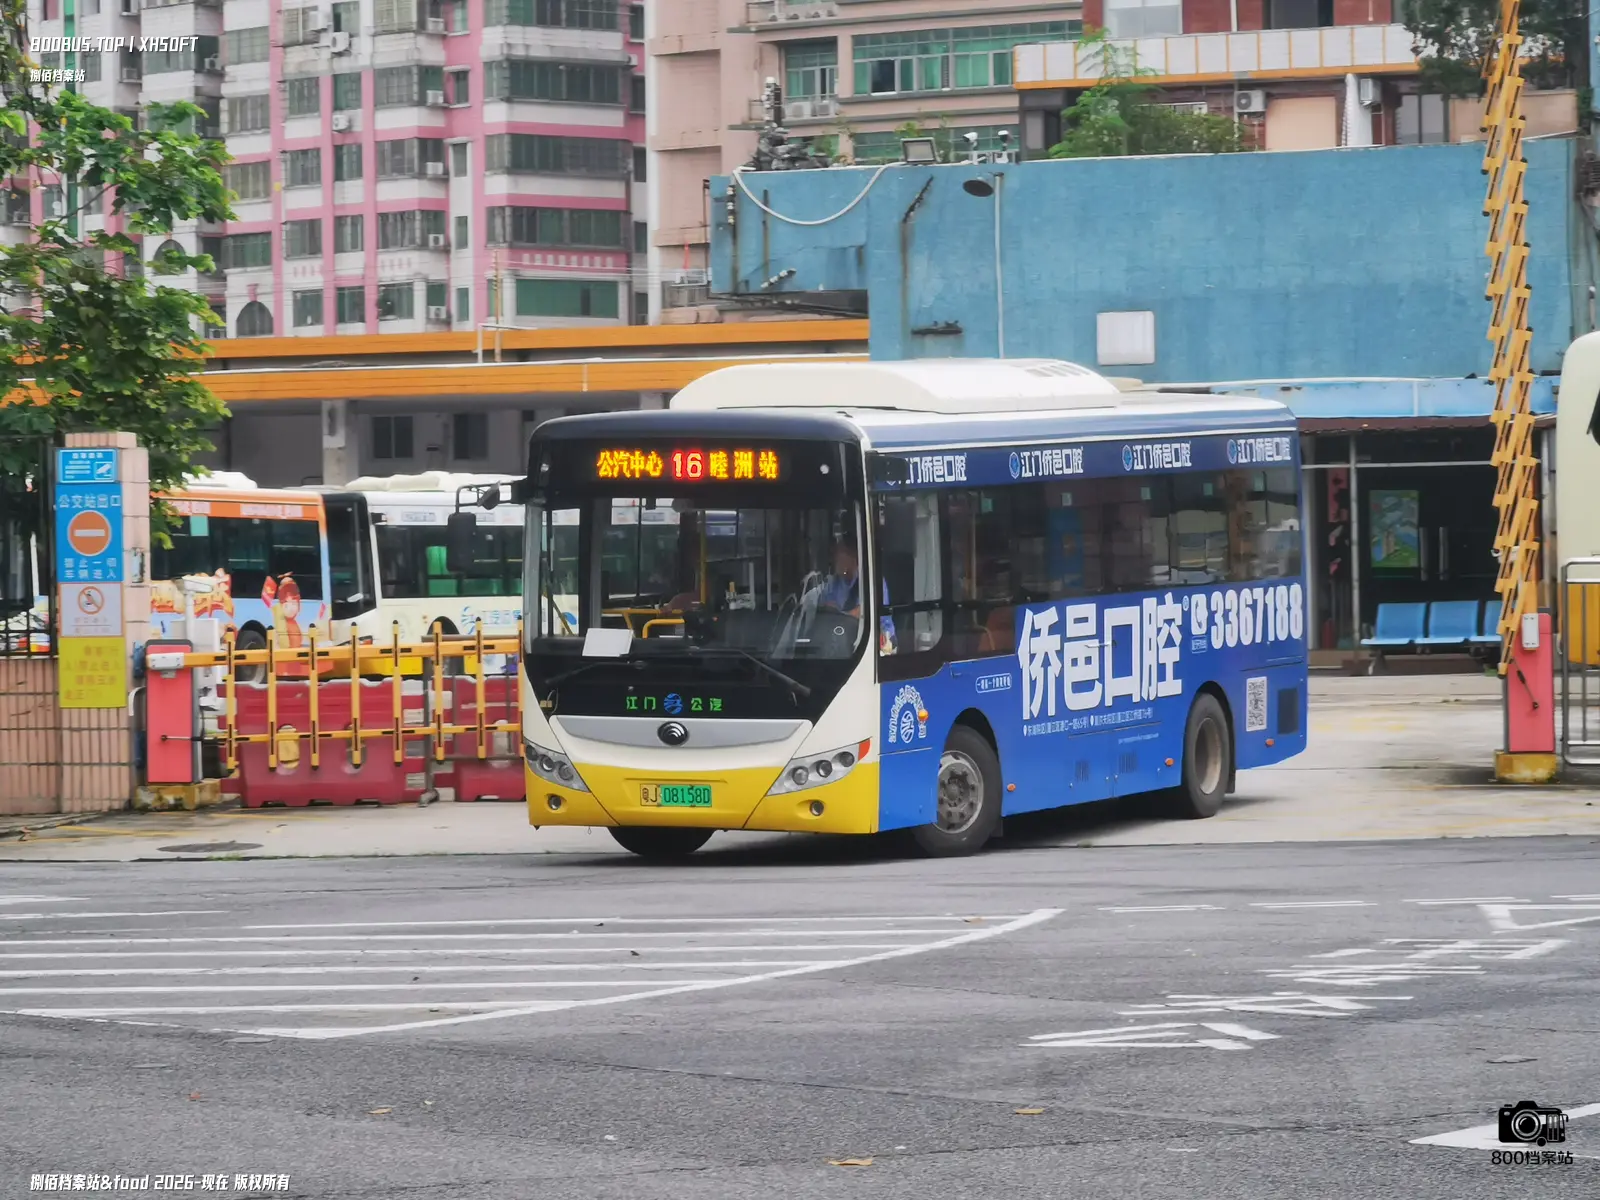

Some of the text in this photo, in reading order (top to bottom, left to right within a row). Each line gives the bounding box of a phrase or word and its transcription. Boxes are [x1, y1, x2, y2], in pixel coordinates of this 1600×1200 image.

[597, 449, 664, 479] 公汽中心
[672, 452, 703, 479] 16
[1020, 447, 1084, 478] 江门侨邑口腔
[1133, 442, 1192, 471] 江门侨邑口腔
[1210, 583, 1303, 650] 3367188
[1018, 592, 1182, 720] 侨邑口腔
[626, 696, 657, 711] 江门
